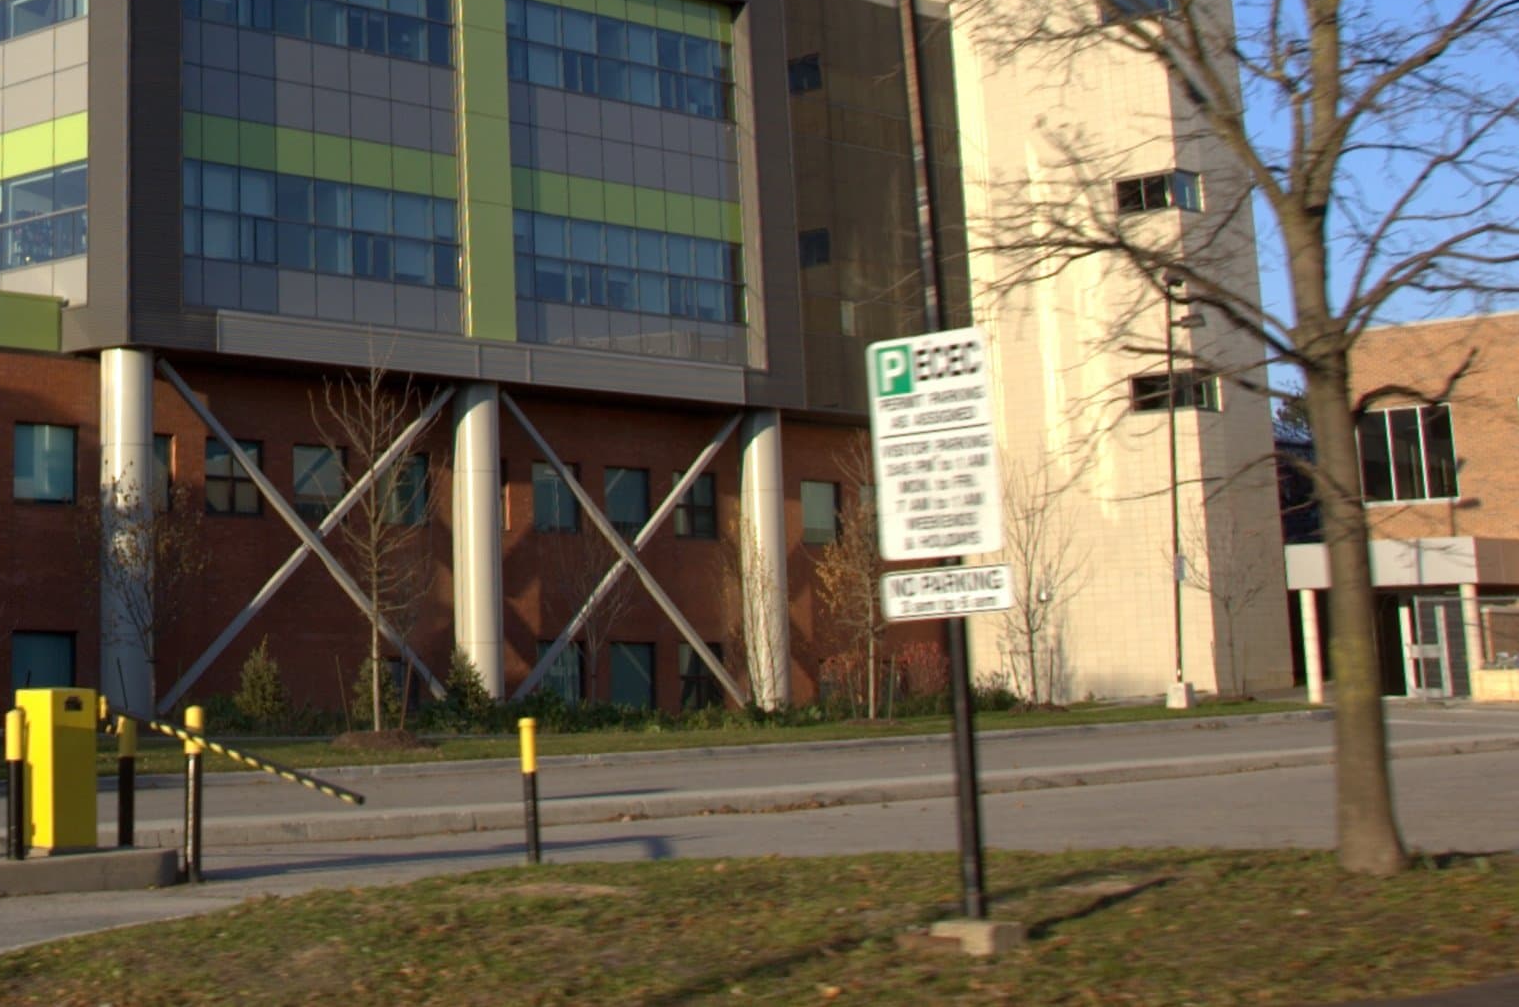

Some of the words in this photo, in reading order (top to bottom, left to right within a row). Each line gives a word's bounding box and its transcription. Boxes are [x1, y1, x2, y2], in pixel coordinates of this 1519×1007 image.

[882, 350, 906, 392] P
[879, 393, 924, 411] PERMIT
[929, 385, 985, 404] PARKING
[914, 406, 975, 426] ASSIGNED
[881, 440, 929, 458] VISITOR
[934, 433, 991, 452] PARKING
[906, 512, 978, 530] WEEKENDS
[918, 531, 982, 548] HOLIDAYS
[890, 577, 916, 597] NO
[920, 569, 1005, 595] PARKING
